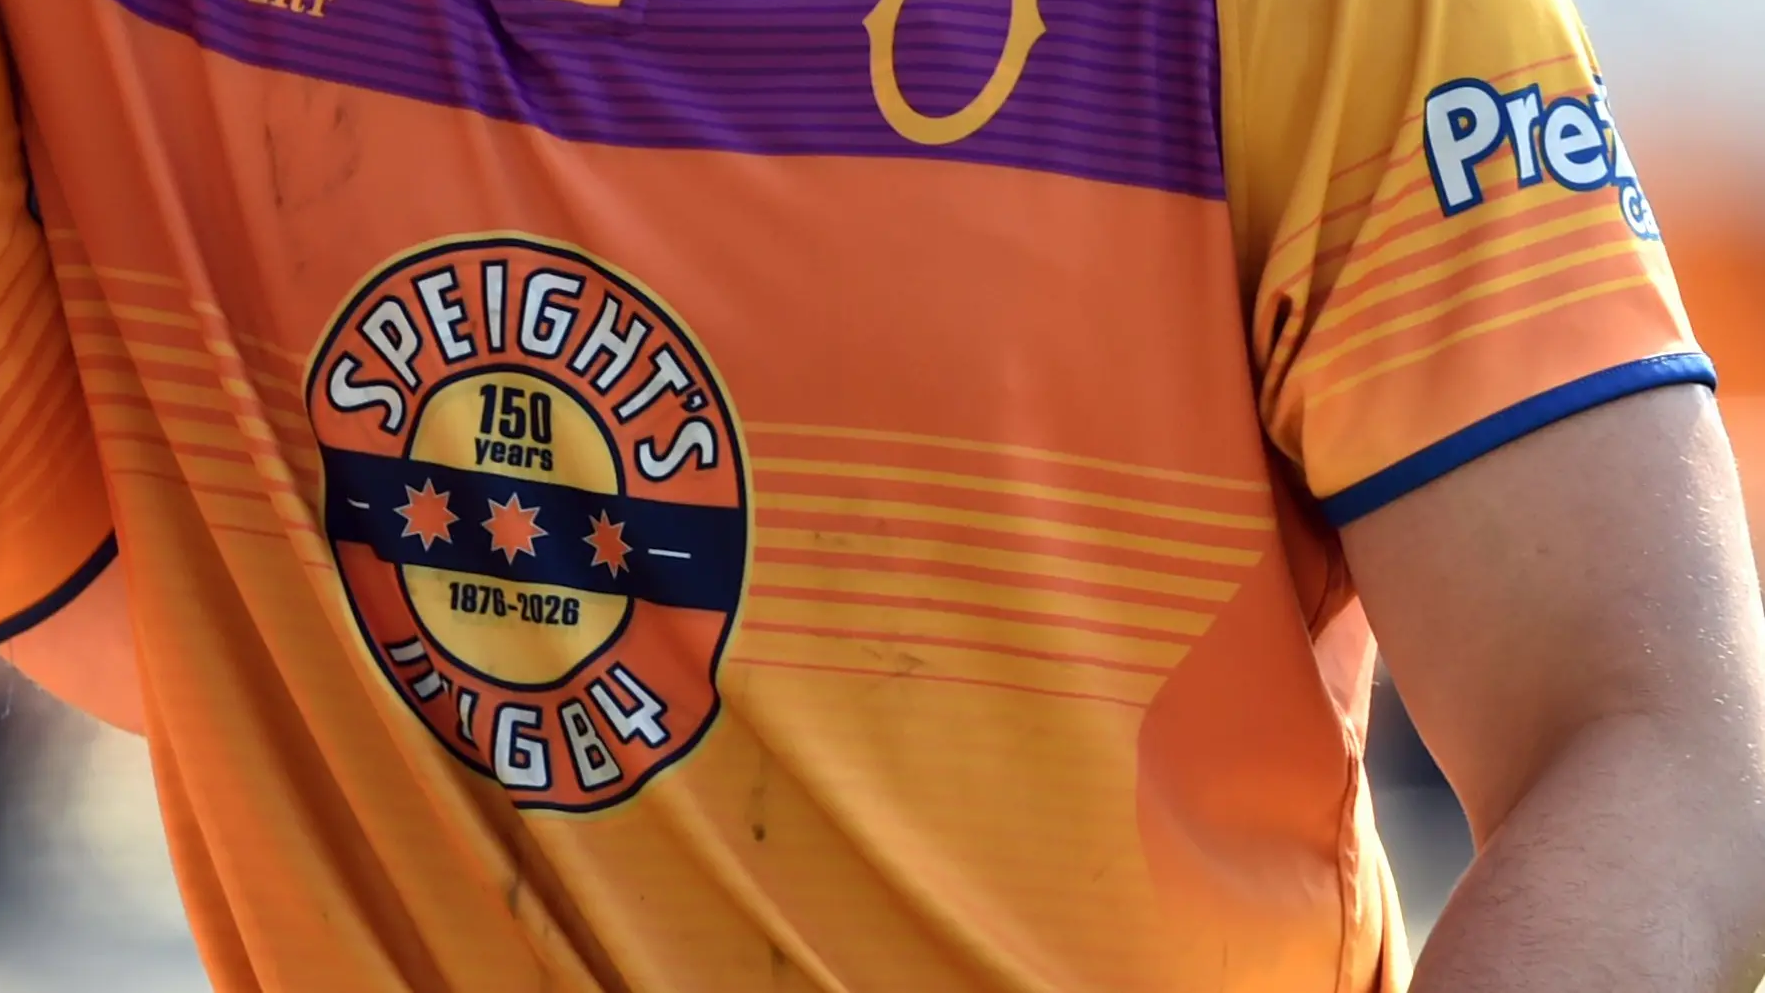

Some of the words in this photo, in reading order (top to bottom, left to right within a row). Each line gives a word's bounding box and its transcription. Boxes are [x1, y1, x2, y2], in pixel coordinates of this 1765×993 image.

[326, 258, 718, 483] SPEIGHT'S
[479, 383, 553, 444] 150
[474, 436, 554, 472] years
[448, 580, 581, 627] 1876-2026
